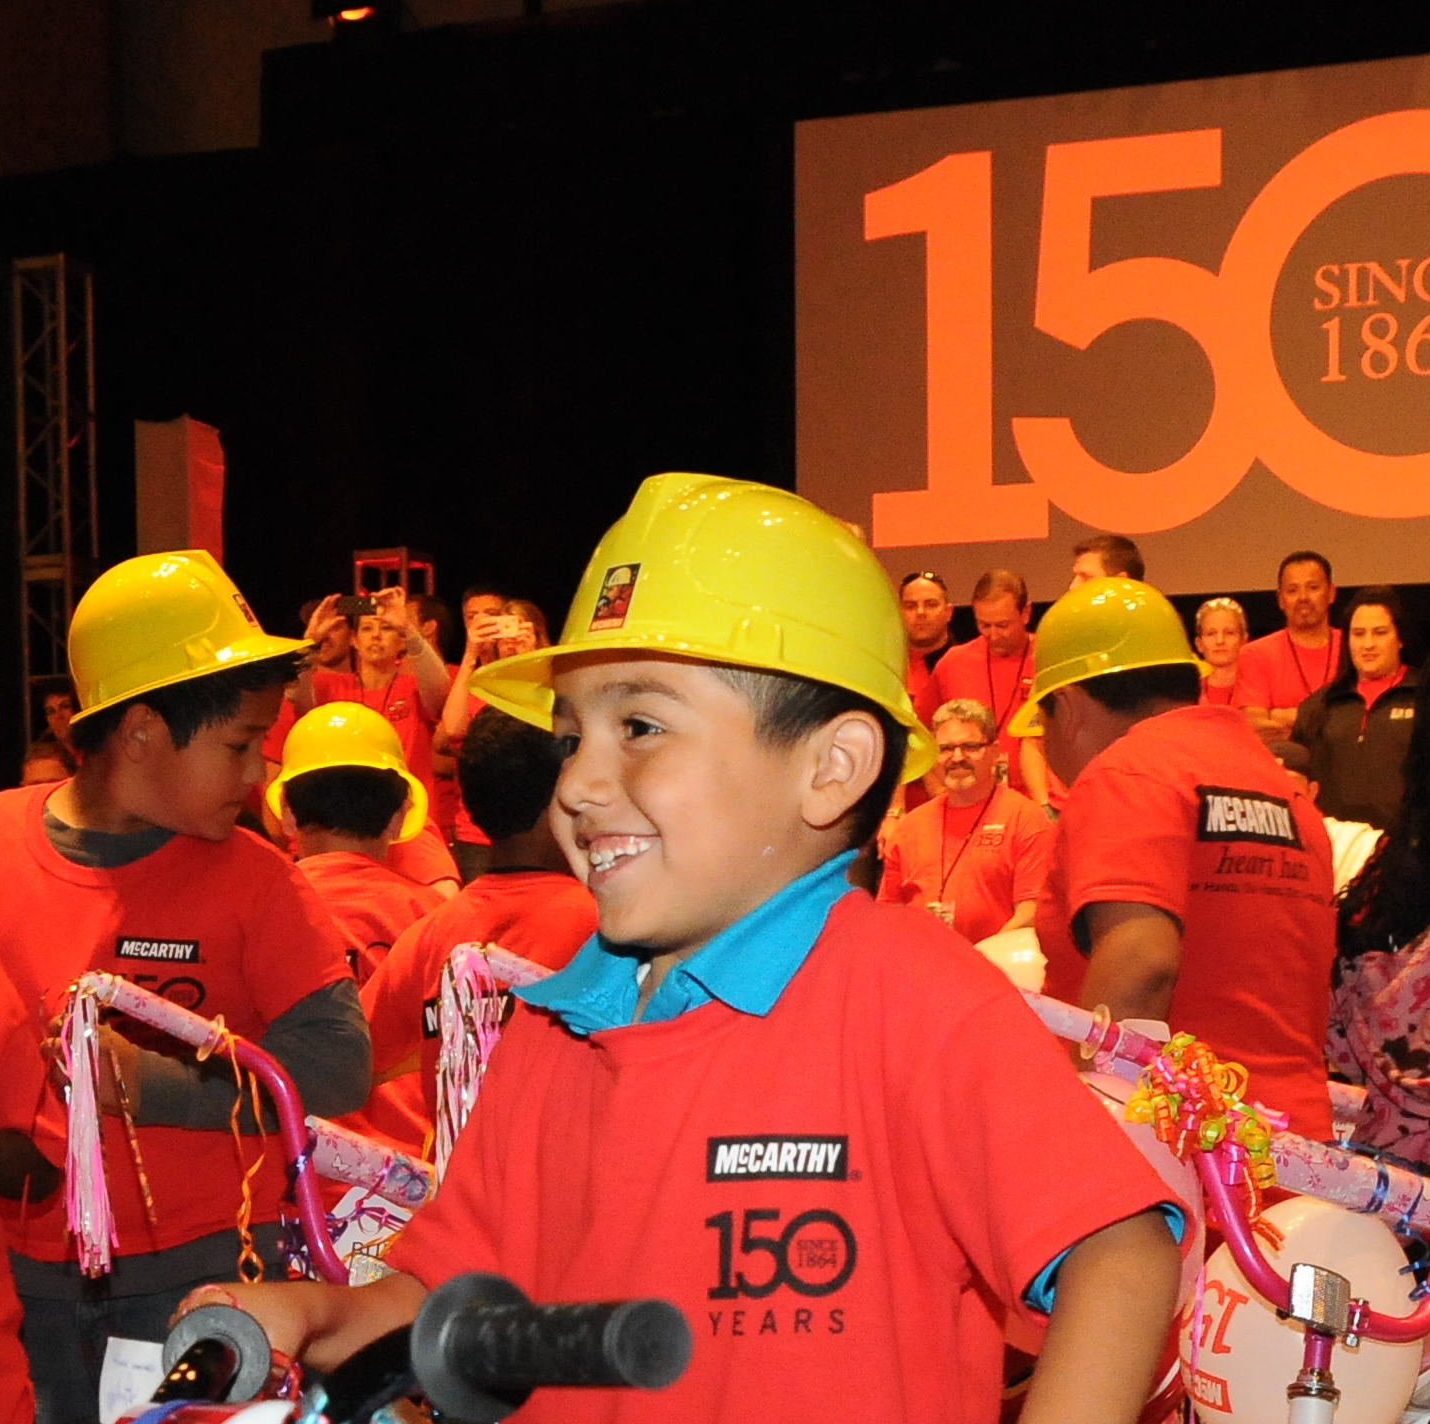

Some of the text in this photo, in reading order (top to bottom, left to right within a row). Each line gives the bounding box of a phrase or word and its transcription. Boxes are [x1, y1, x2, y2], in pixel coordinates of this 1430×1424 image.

[120, 940, 194, 960] McCARTHY
[714, 1141, 842, 1175] McCARTHY
[705, 1208, 858, 1299] 150
[708, 1307, 846, 1337] YEARS
